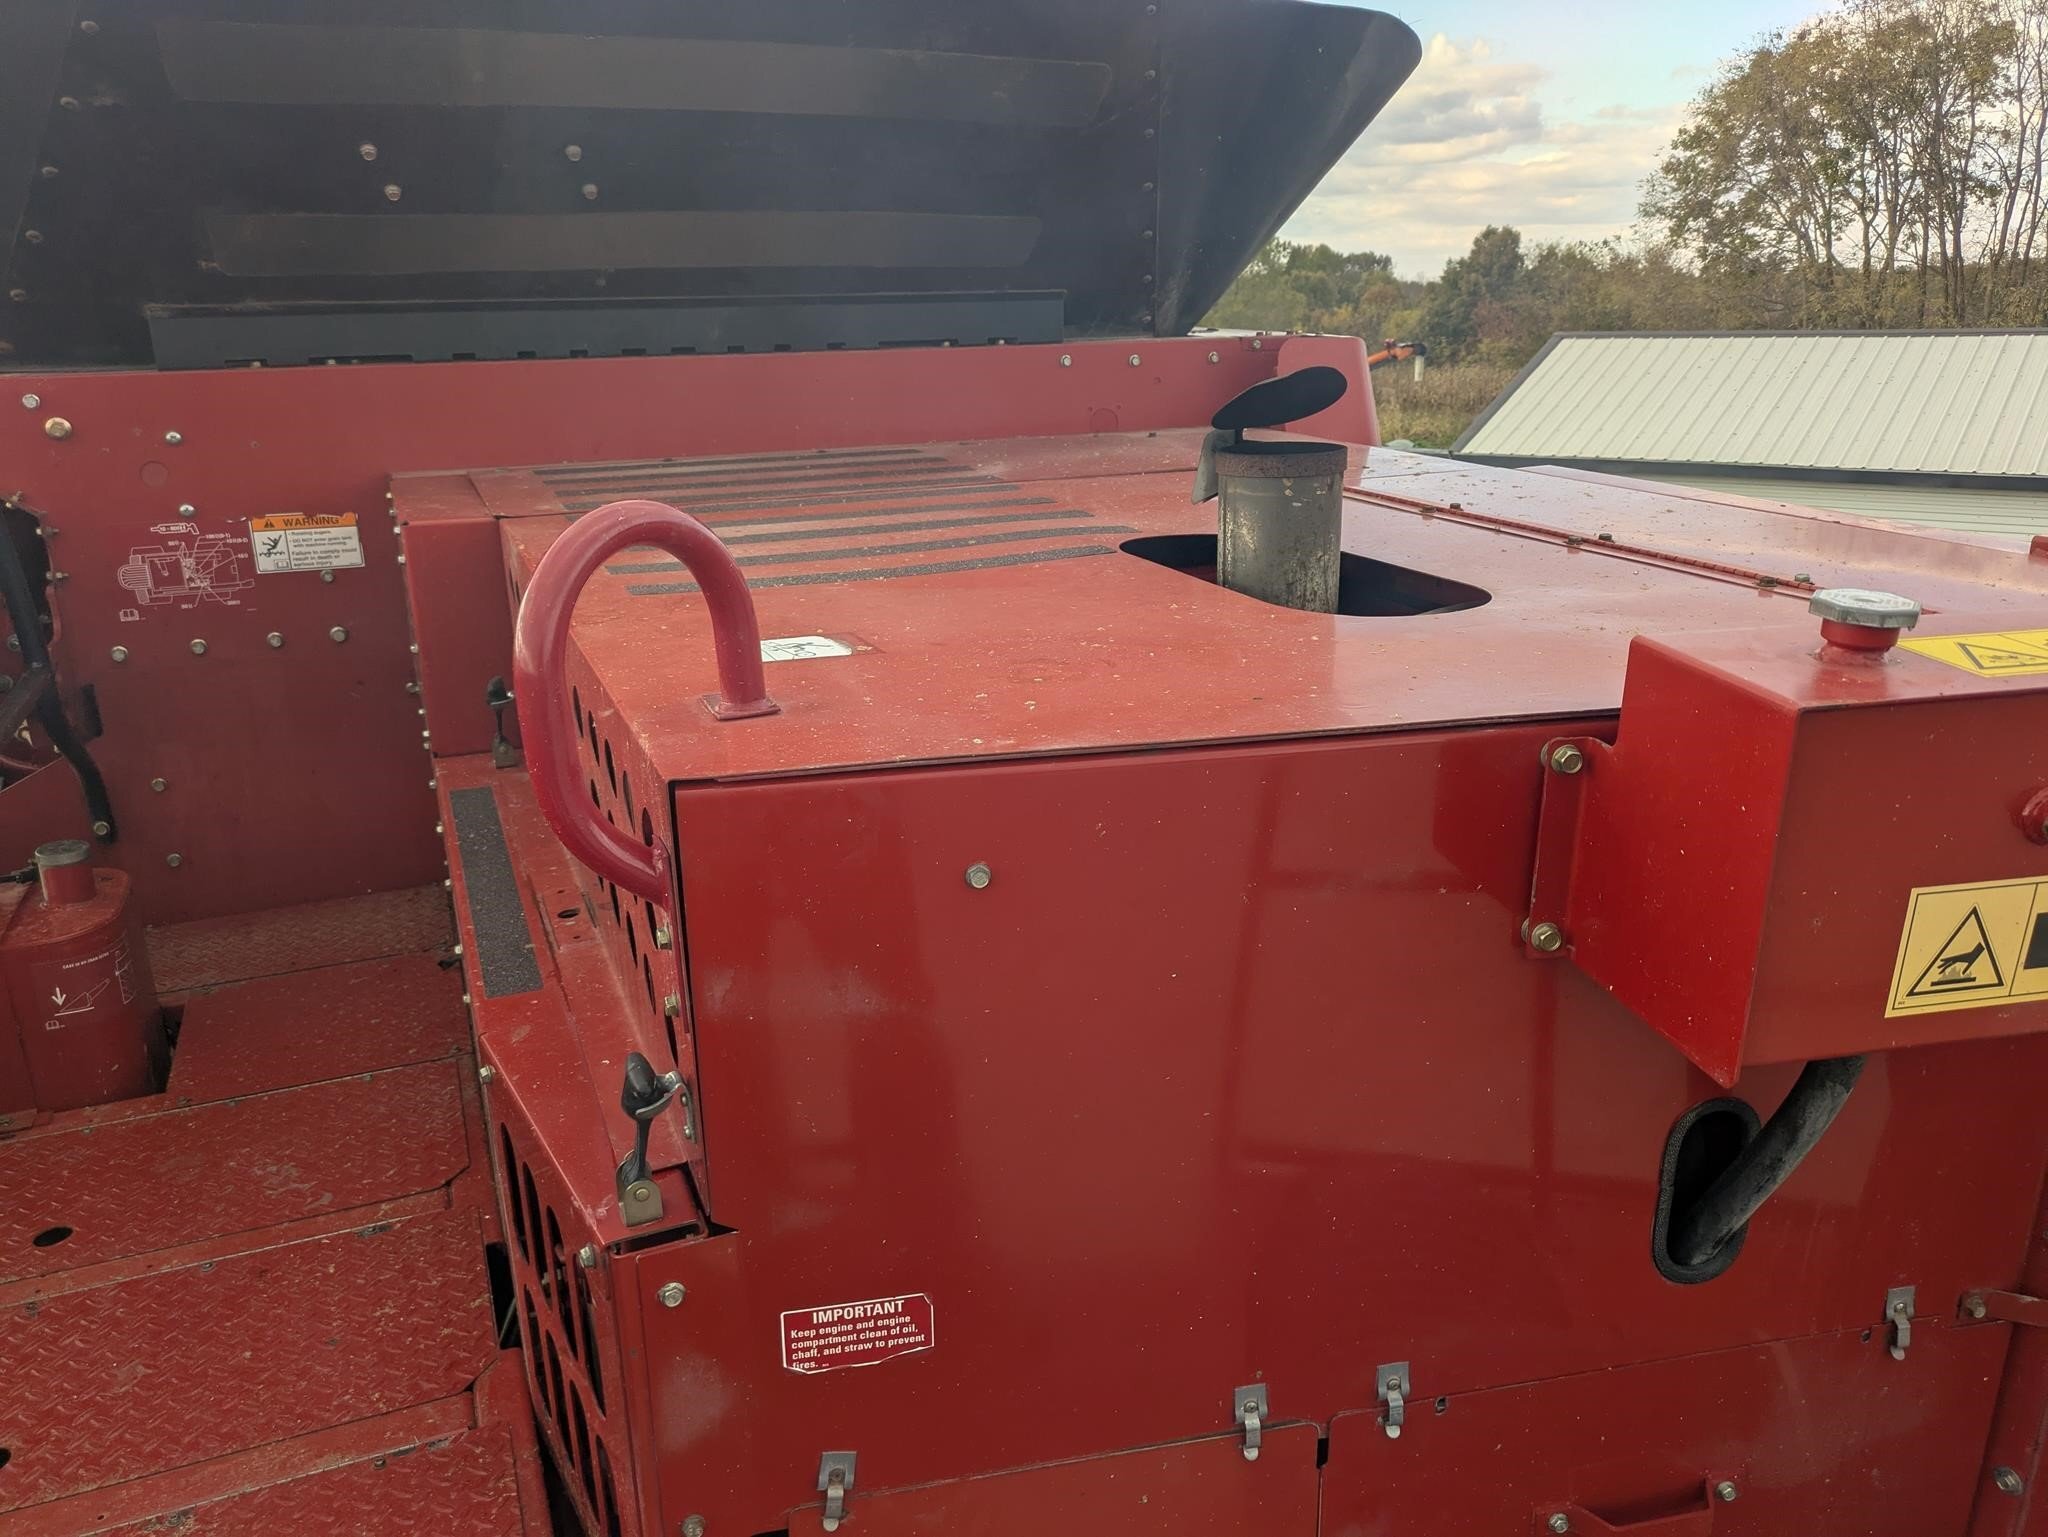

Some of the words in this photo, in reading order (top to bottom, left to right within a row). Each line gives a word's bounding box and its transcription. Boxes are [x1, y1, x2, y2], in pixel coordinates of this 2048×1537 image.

[282, 516, 339, 527] WARNING
[813, 1300, 904, 1324] IMPORTANT
[791, 1329, 817, 1339] Keep
[819, 1323, 853, 1335] engine
[856, 1319, 875, 1330] and
[877, 1315, 911, 1327] engine
[791, 1332, 857, 1349] compartment
[860, 1330, 888, 1340] clean
[890, 1325, 900, 1335] of
[902, 1323, 918, 1333] oil,
[792, 1349, 821, 1360] chaff,
[823, 1345, 842, 1355] and
[844, 1342, 873, 1353] straw
[875, 1340, 886, 1348] to
[888, 1333, 925, 1348] prevent
[792, 1361, 819, 1370] fires.
